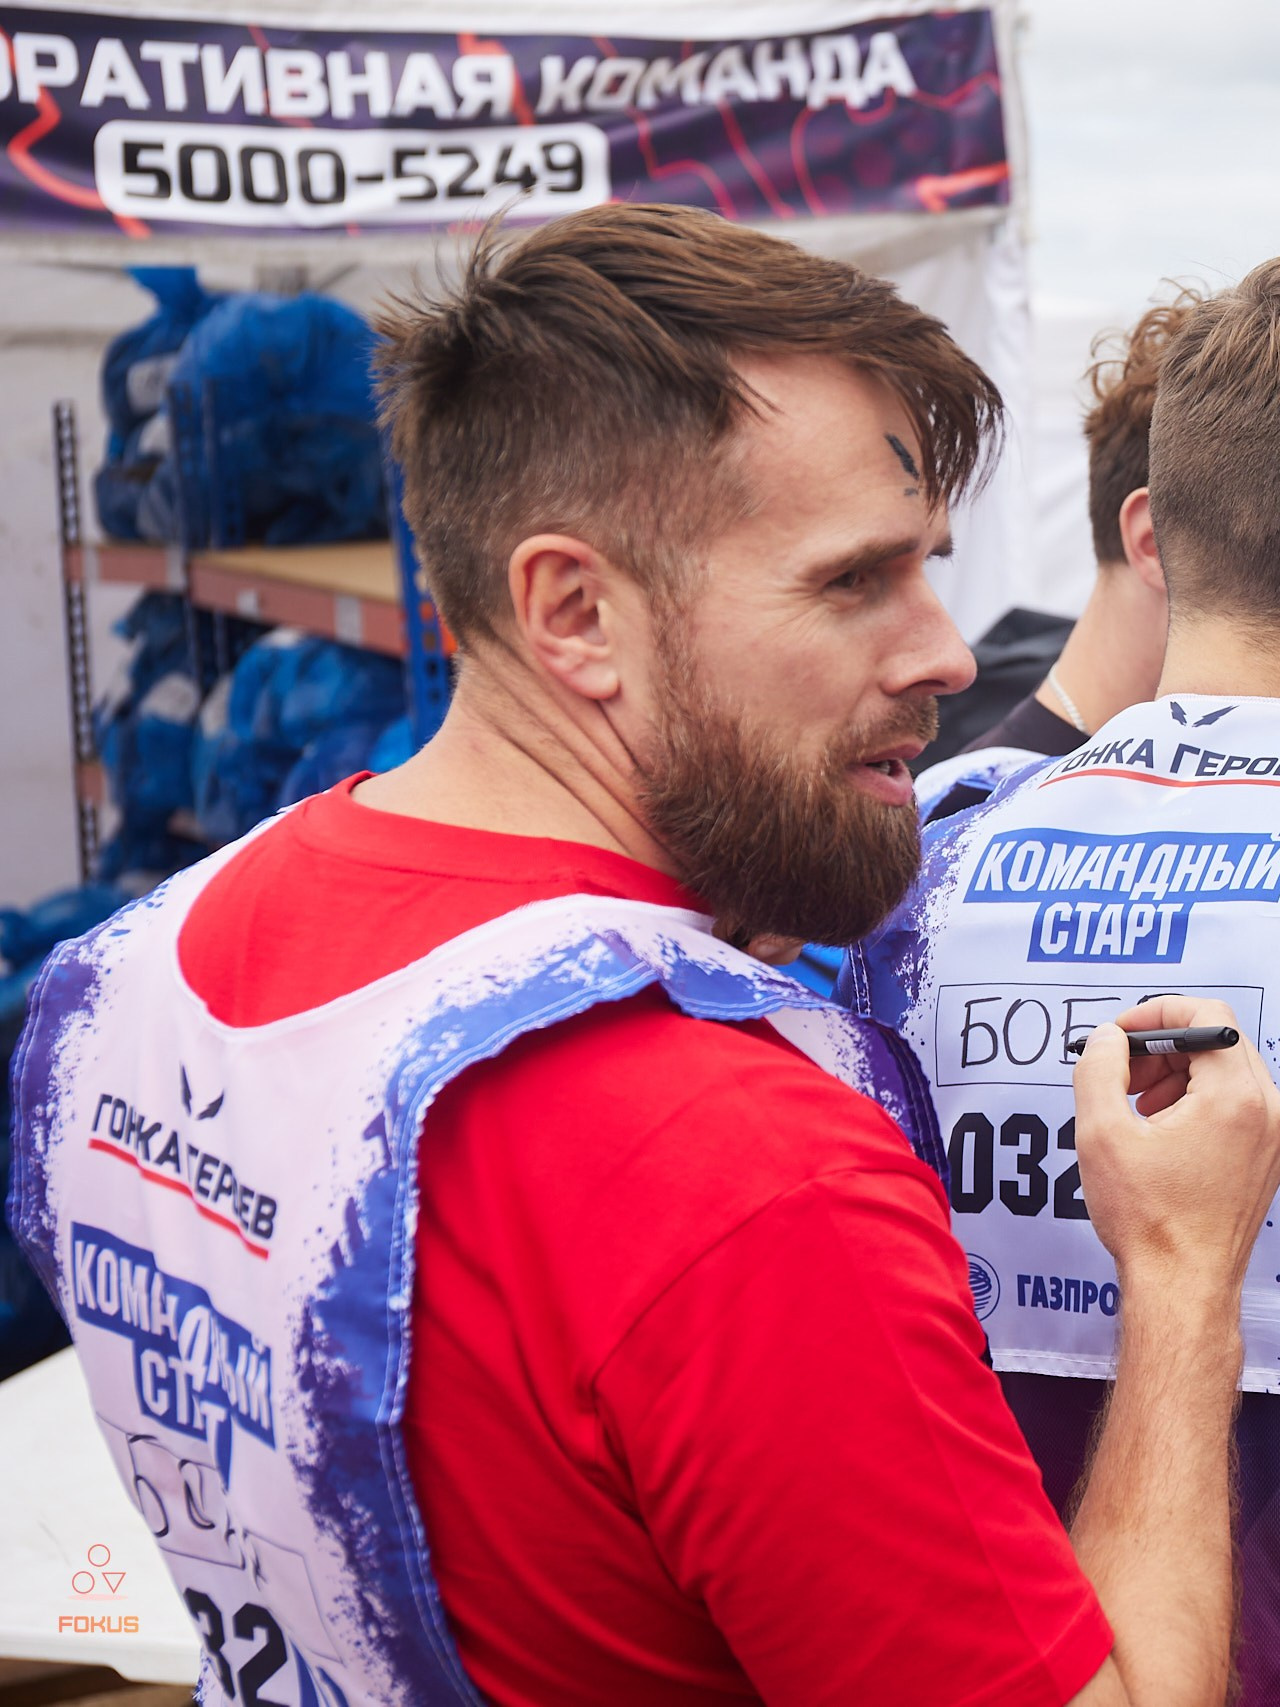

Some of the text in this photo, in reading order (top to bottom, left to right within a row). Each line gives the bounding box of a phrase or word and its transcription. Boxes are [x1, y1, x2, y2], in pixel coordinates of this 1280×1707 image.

[0, 32, 917, 122] РАТИВНАЯ КОМАНДА
[121, 139, 584, 205] 5000-5249
[1045, 738, 1154, 780] ГОНКА
[1039, 903, 1182, 956] СТАРТ
[960, 994, 1187, 1068] БОБ
